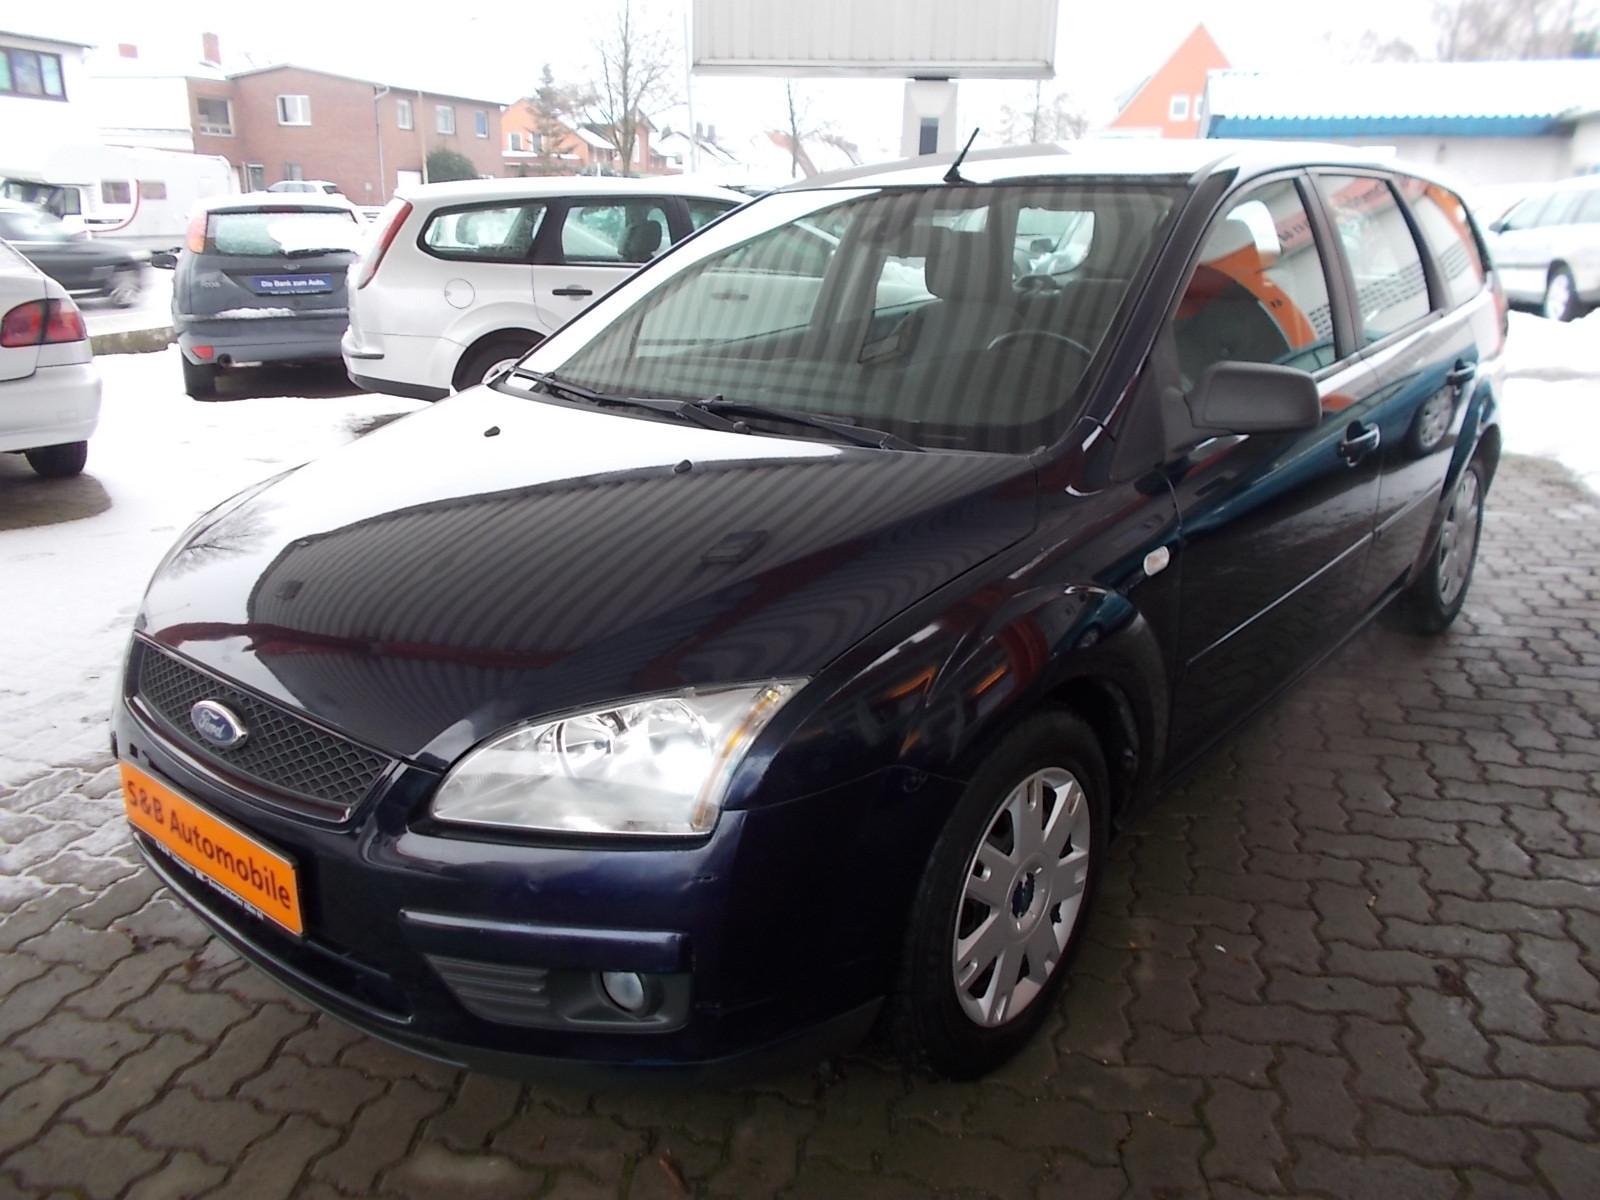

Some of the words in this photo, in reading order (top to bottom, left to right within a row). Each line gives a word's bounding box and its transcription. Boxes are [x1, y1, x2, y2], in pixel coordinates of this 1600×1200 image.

[260, 279, 273, 288] Die
[273, 279, 292, 288] Bank
[198, 709, 226, 740] Ford
[126, 780, 165, 826] S&B
[170, 808, 292, 911] Automobile
